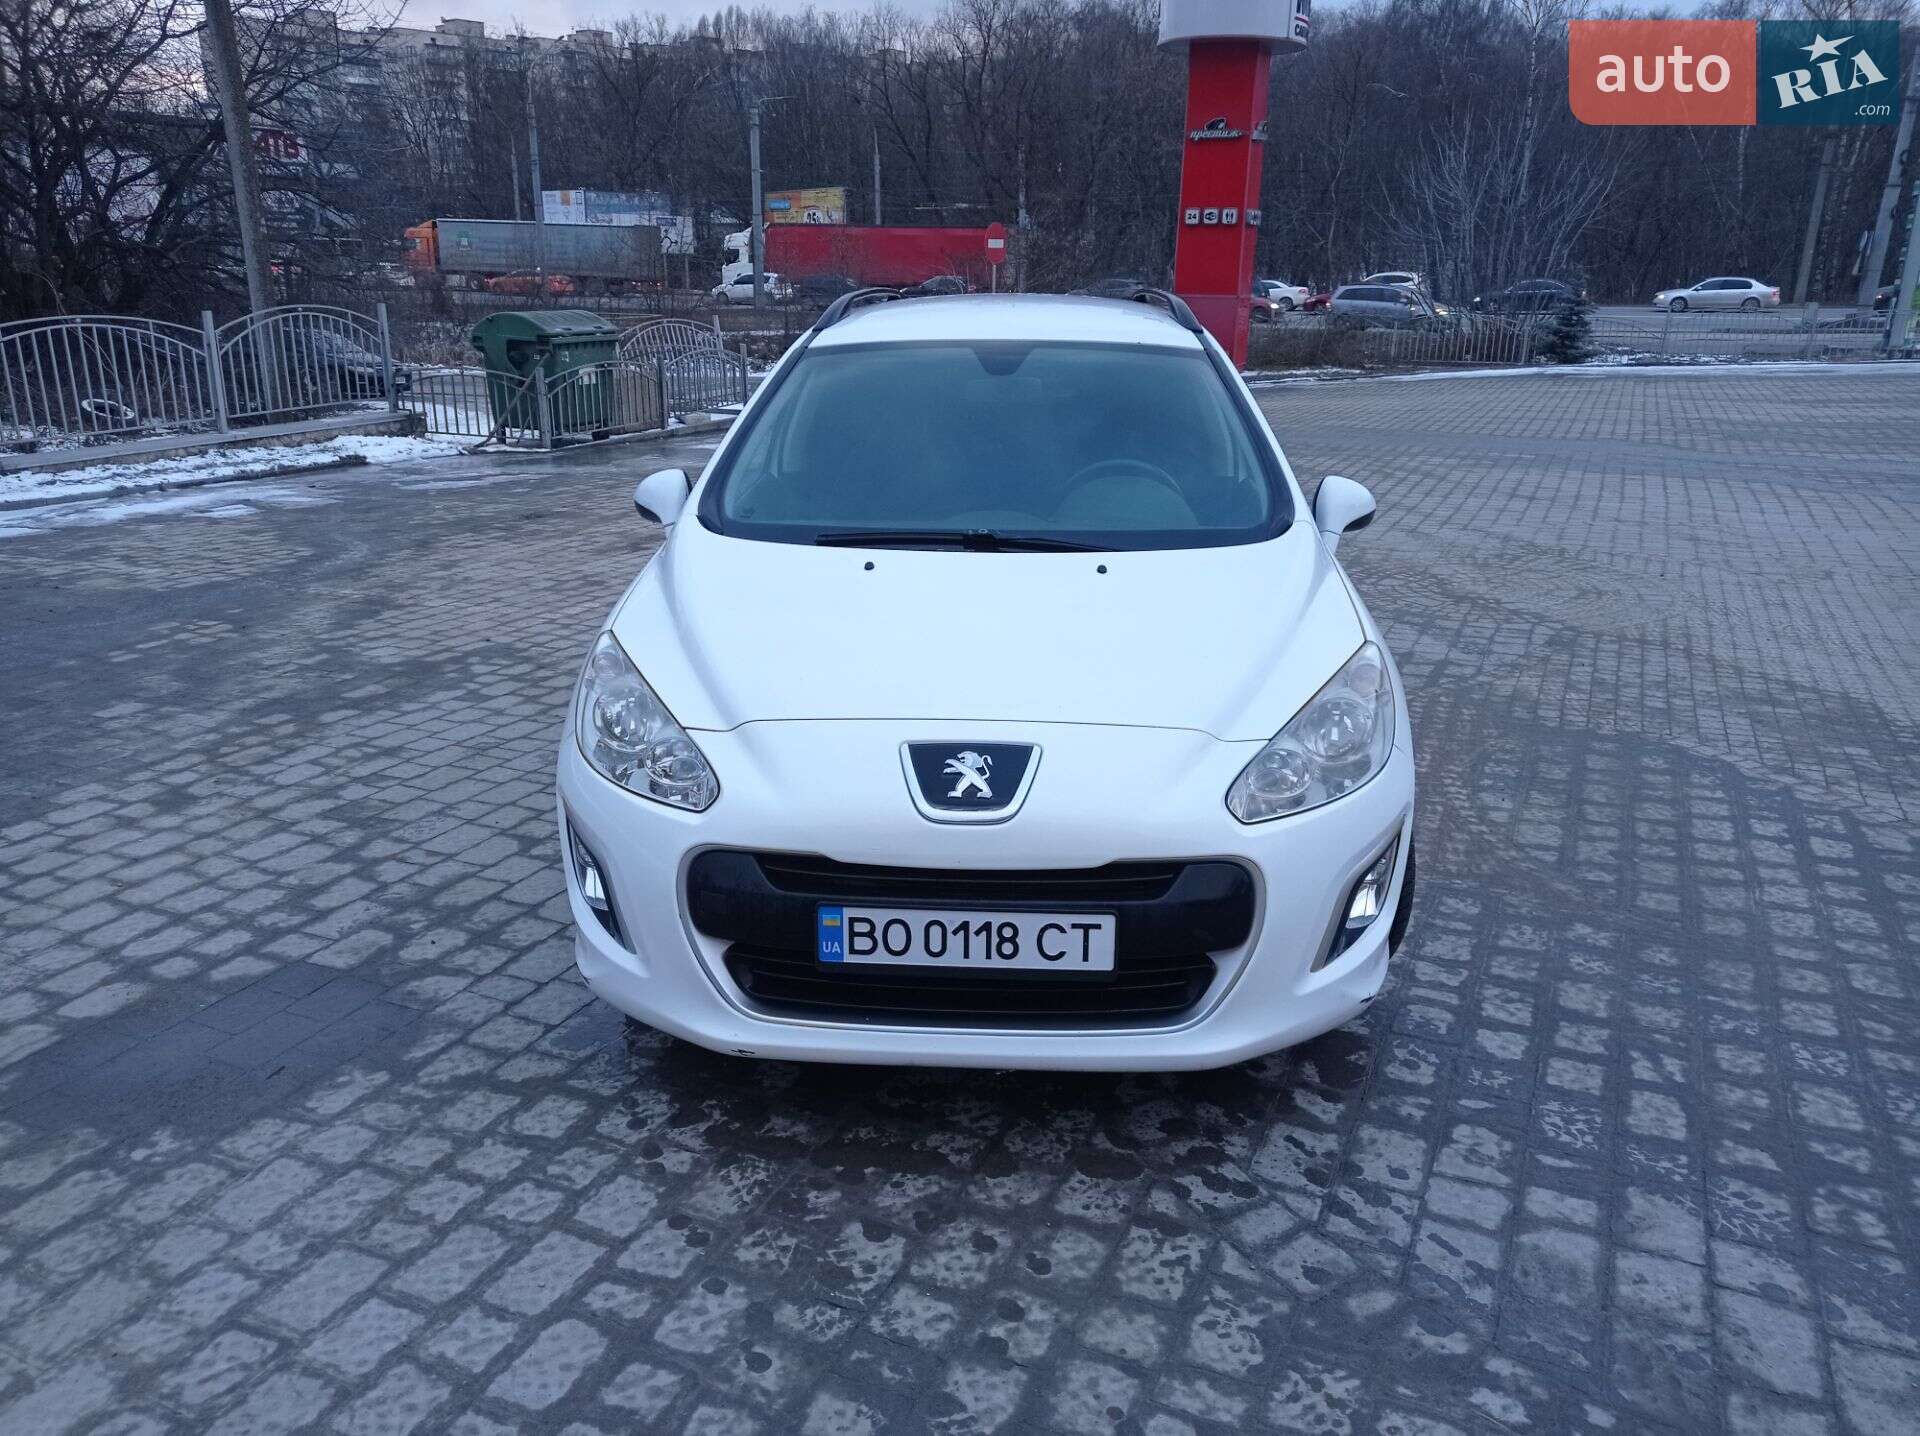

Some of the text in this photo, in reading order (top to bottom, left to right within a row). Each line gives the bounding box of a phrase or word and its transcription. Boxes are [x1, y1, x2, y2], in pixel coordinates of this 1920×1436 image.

[822, 940, 841, 954] UA
[848, 917, 1102, 963] BO 0118 CT
